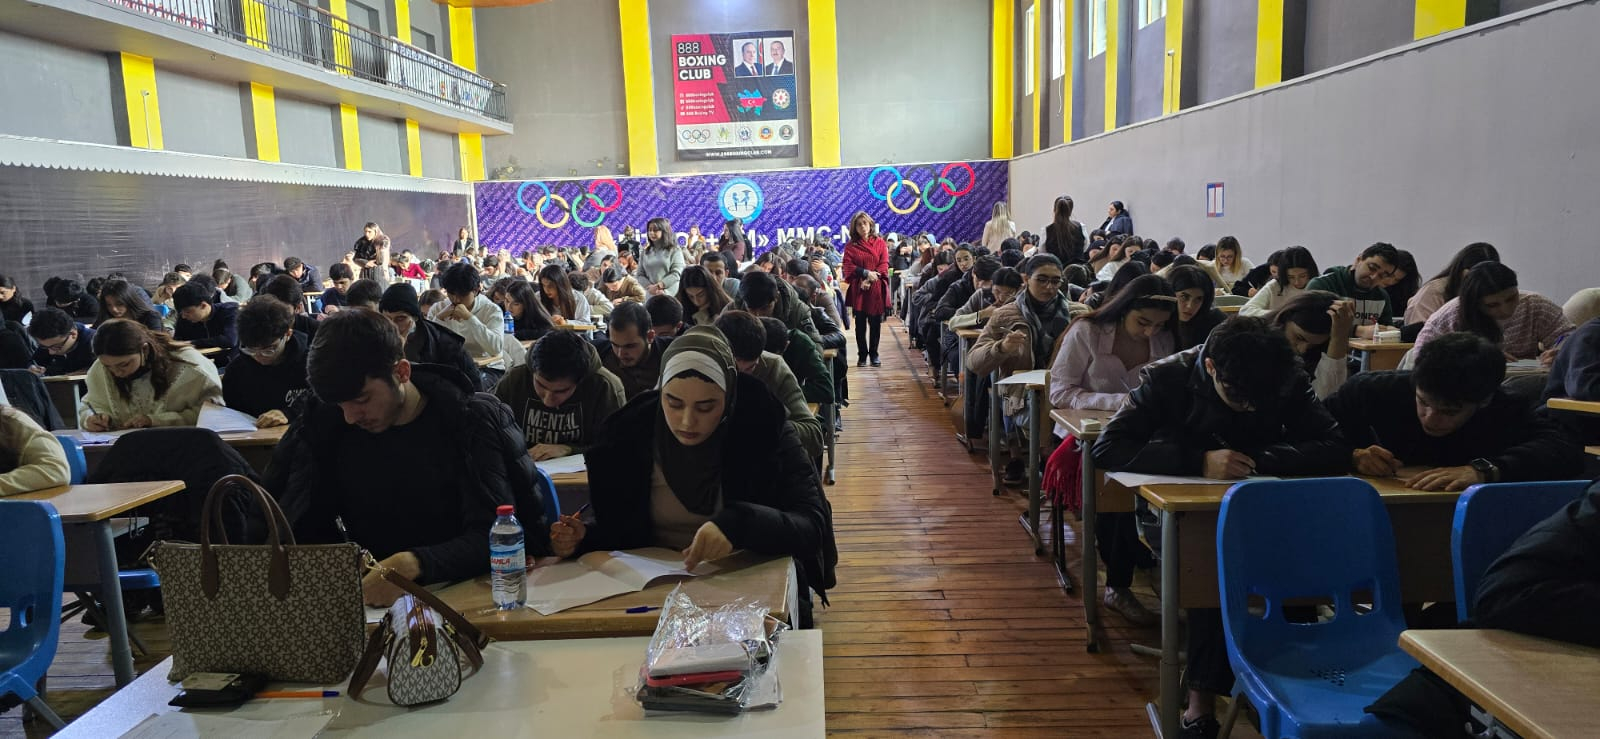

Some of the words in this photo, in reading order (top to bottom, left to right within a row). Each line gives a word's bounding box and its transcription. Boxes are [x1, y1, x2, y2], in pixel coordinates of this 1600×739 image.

[678, 43, 700, 54] 888
[678, 55, 726, 67] BOXING
[679, 69, 711, 80] CLUB
[527, 409, 580, 431] MENTAL
